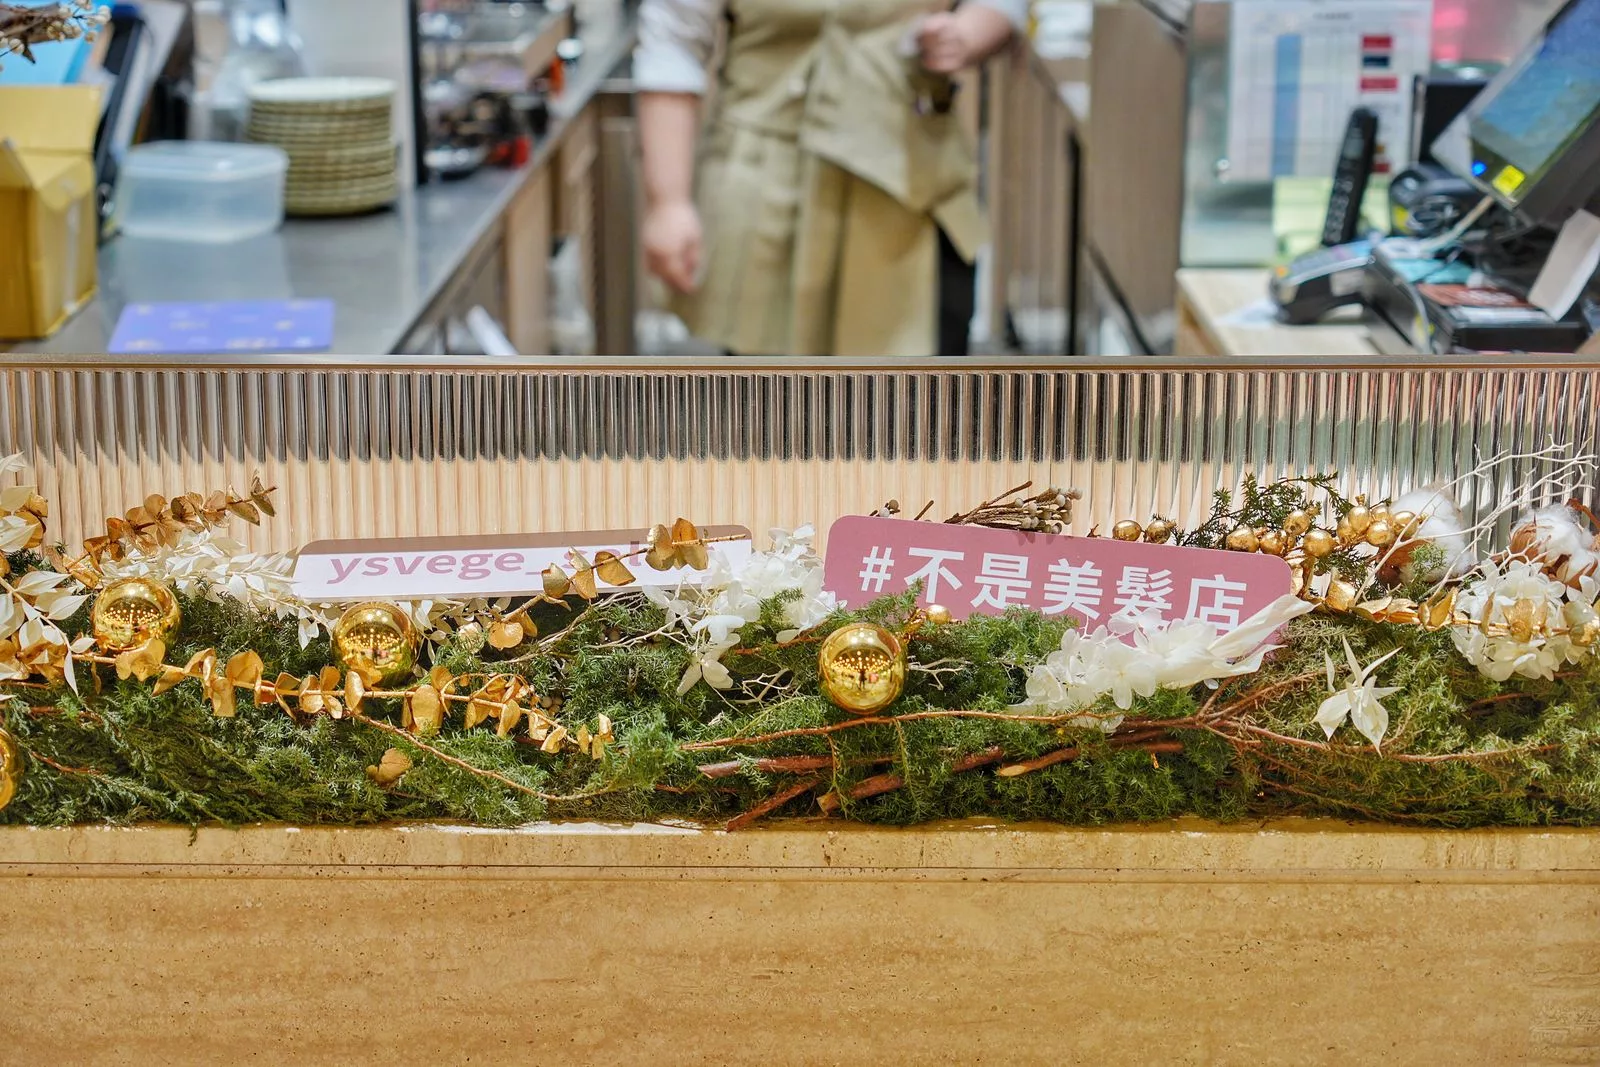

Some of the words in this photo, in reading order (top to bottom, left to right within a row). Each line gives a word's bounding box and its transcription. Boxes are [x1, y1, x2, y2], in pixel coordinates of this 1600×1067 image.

[859, 545, 1247, 633] #不是美髮店
